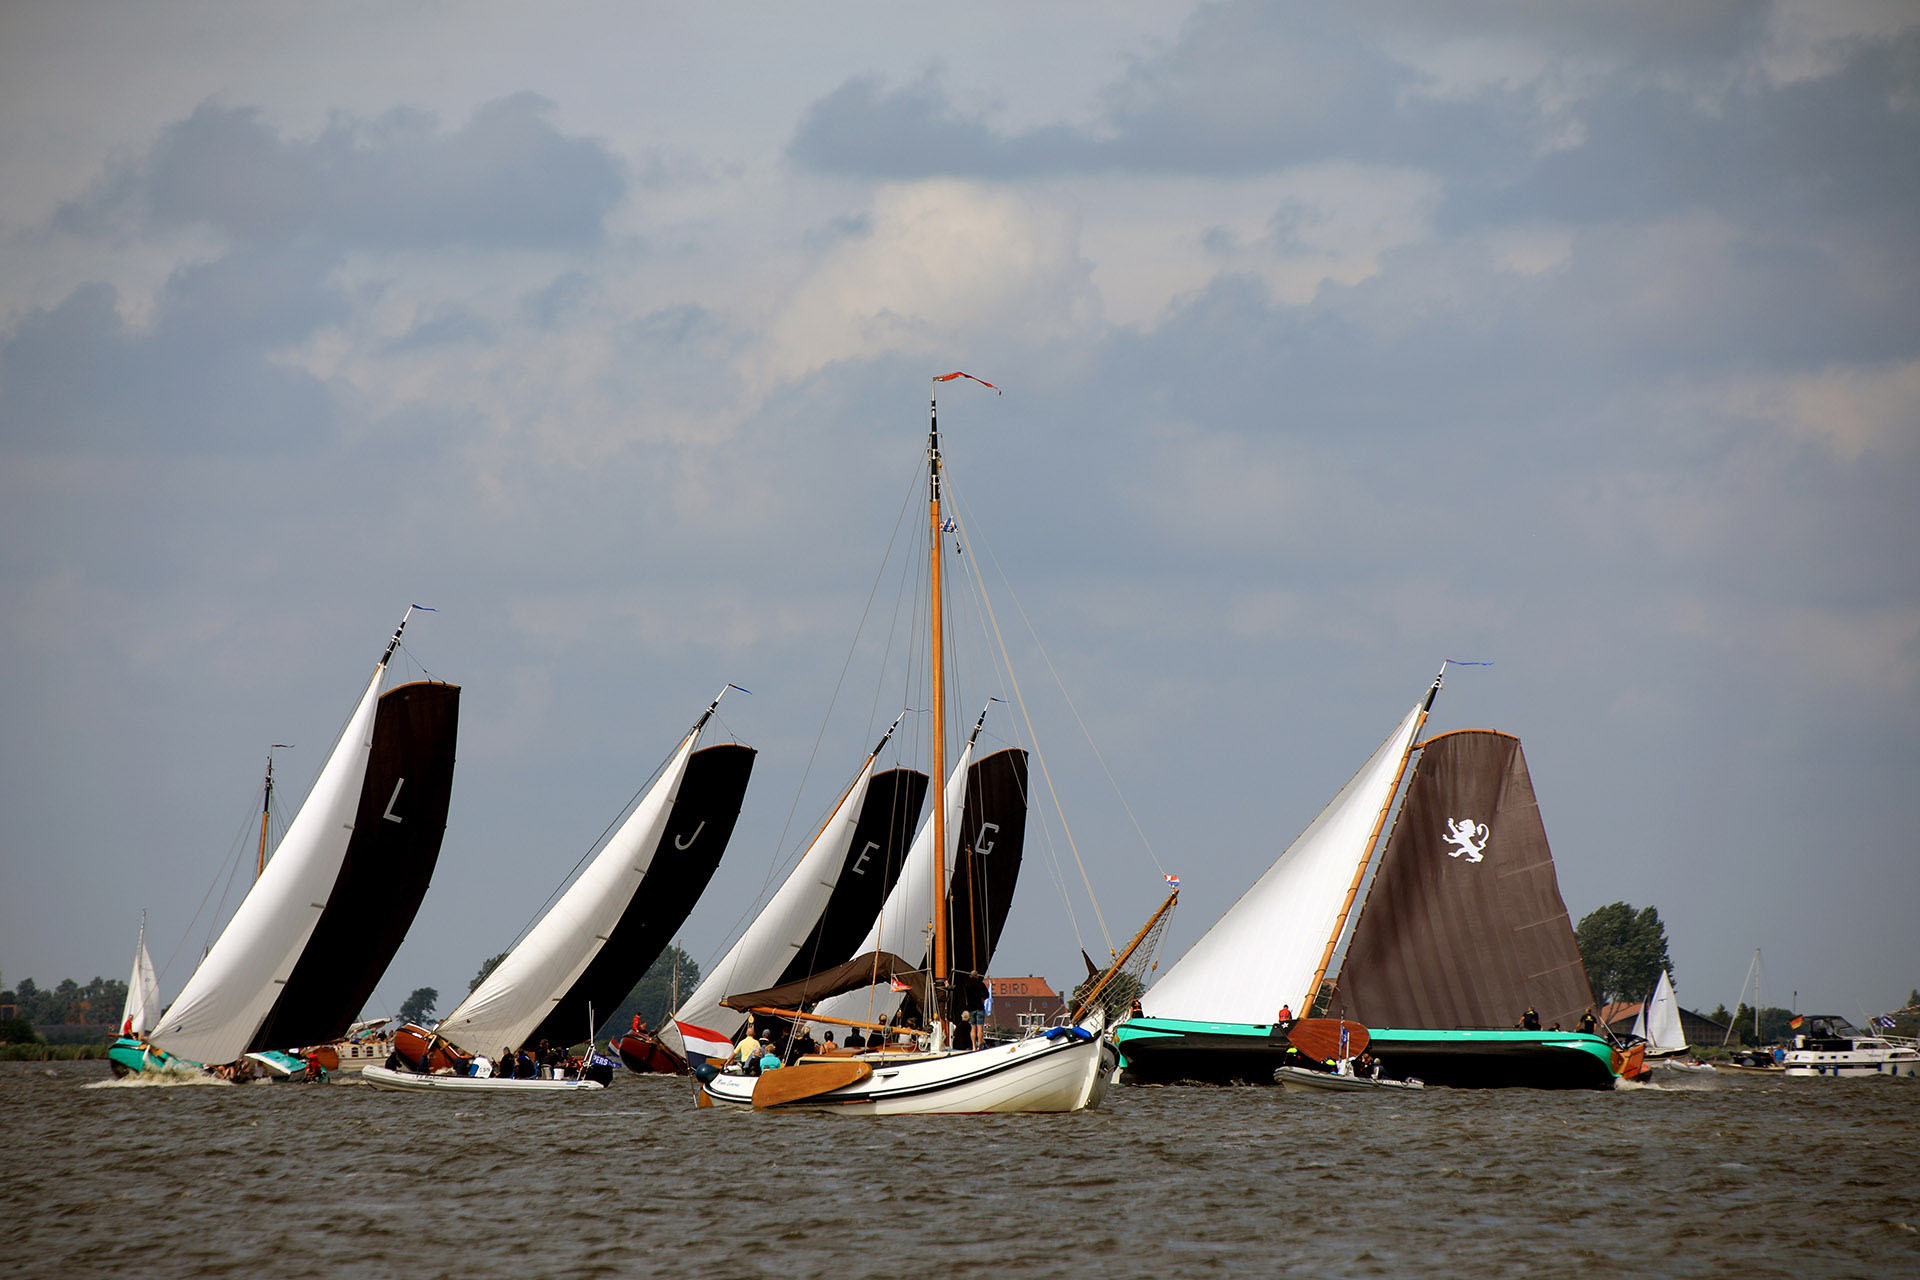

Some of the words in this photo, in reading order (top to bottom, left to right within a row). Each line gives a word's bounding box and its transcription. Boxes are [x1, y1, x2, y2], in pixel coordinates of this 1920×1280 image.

[383, 777, 404, 823] L
[675, 821, 706, 850] J
[975, 822, 999, 855] G
[852, 841, 880, 875] E
[1000, 983, 1029, 995] BIRD
